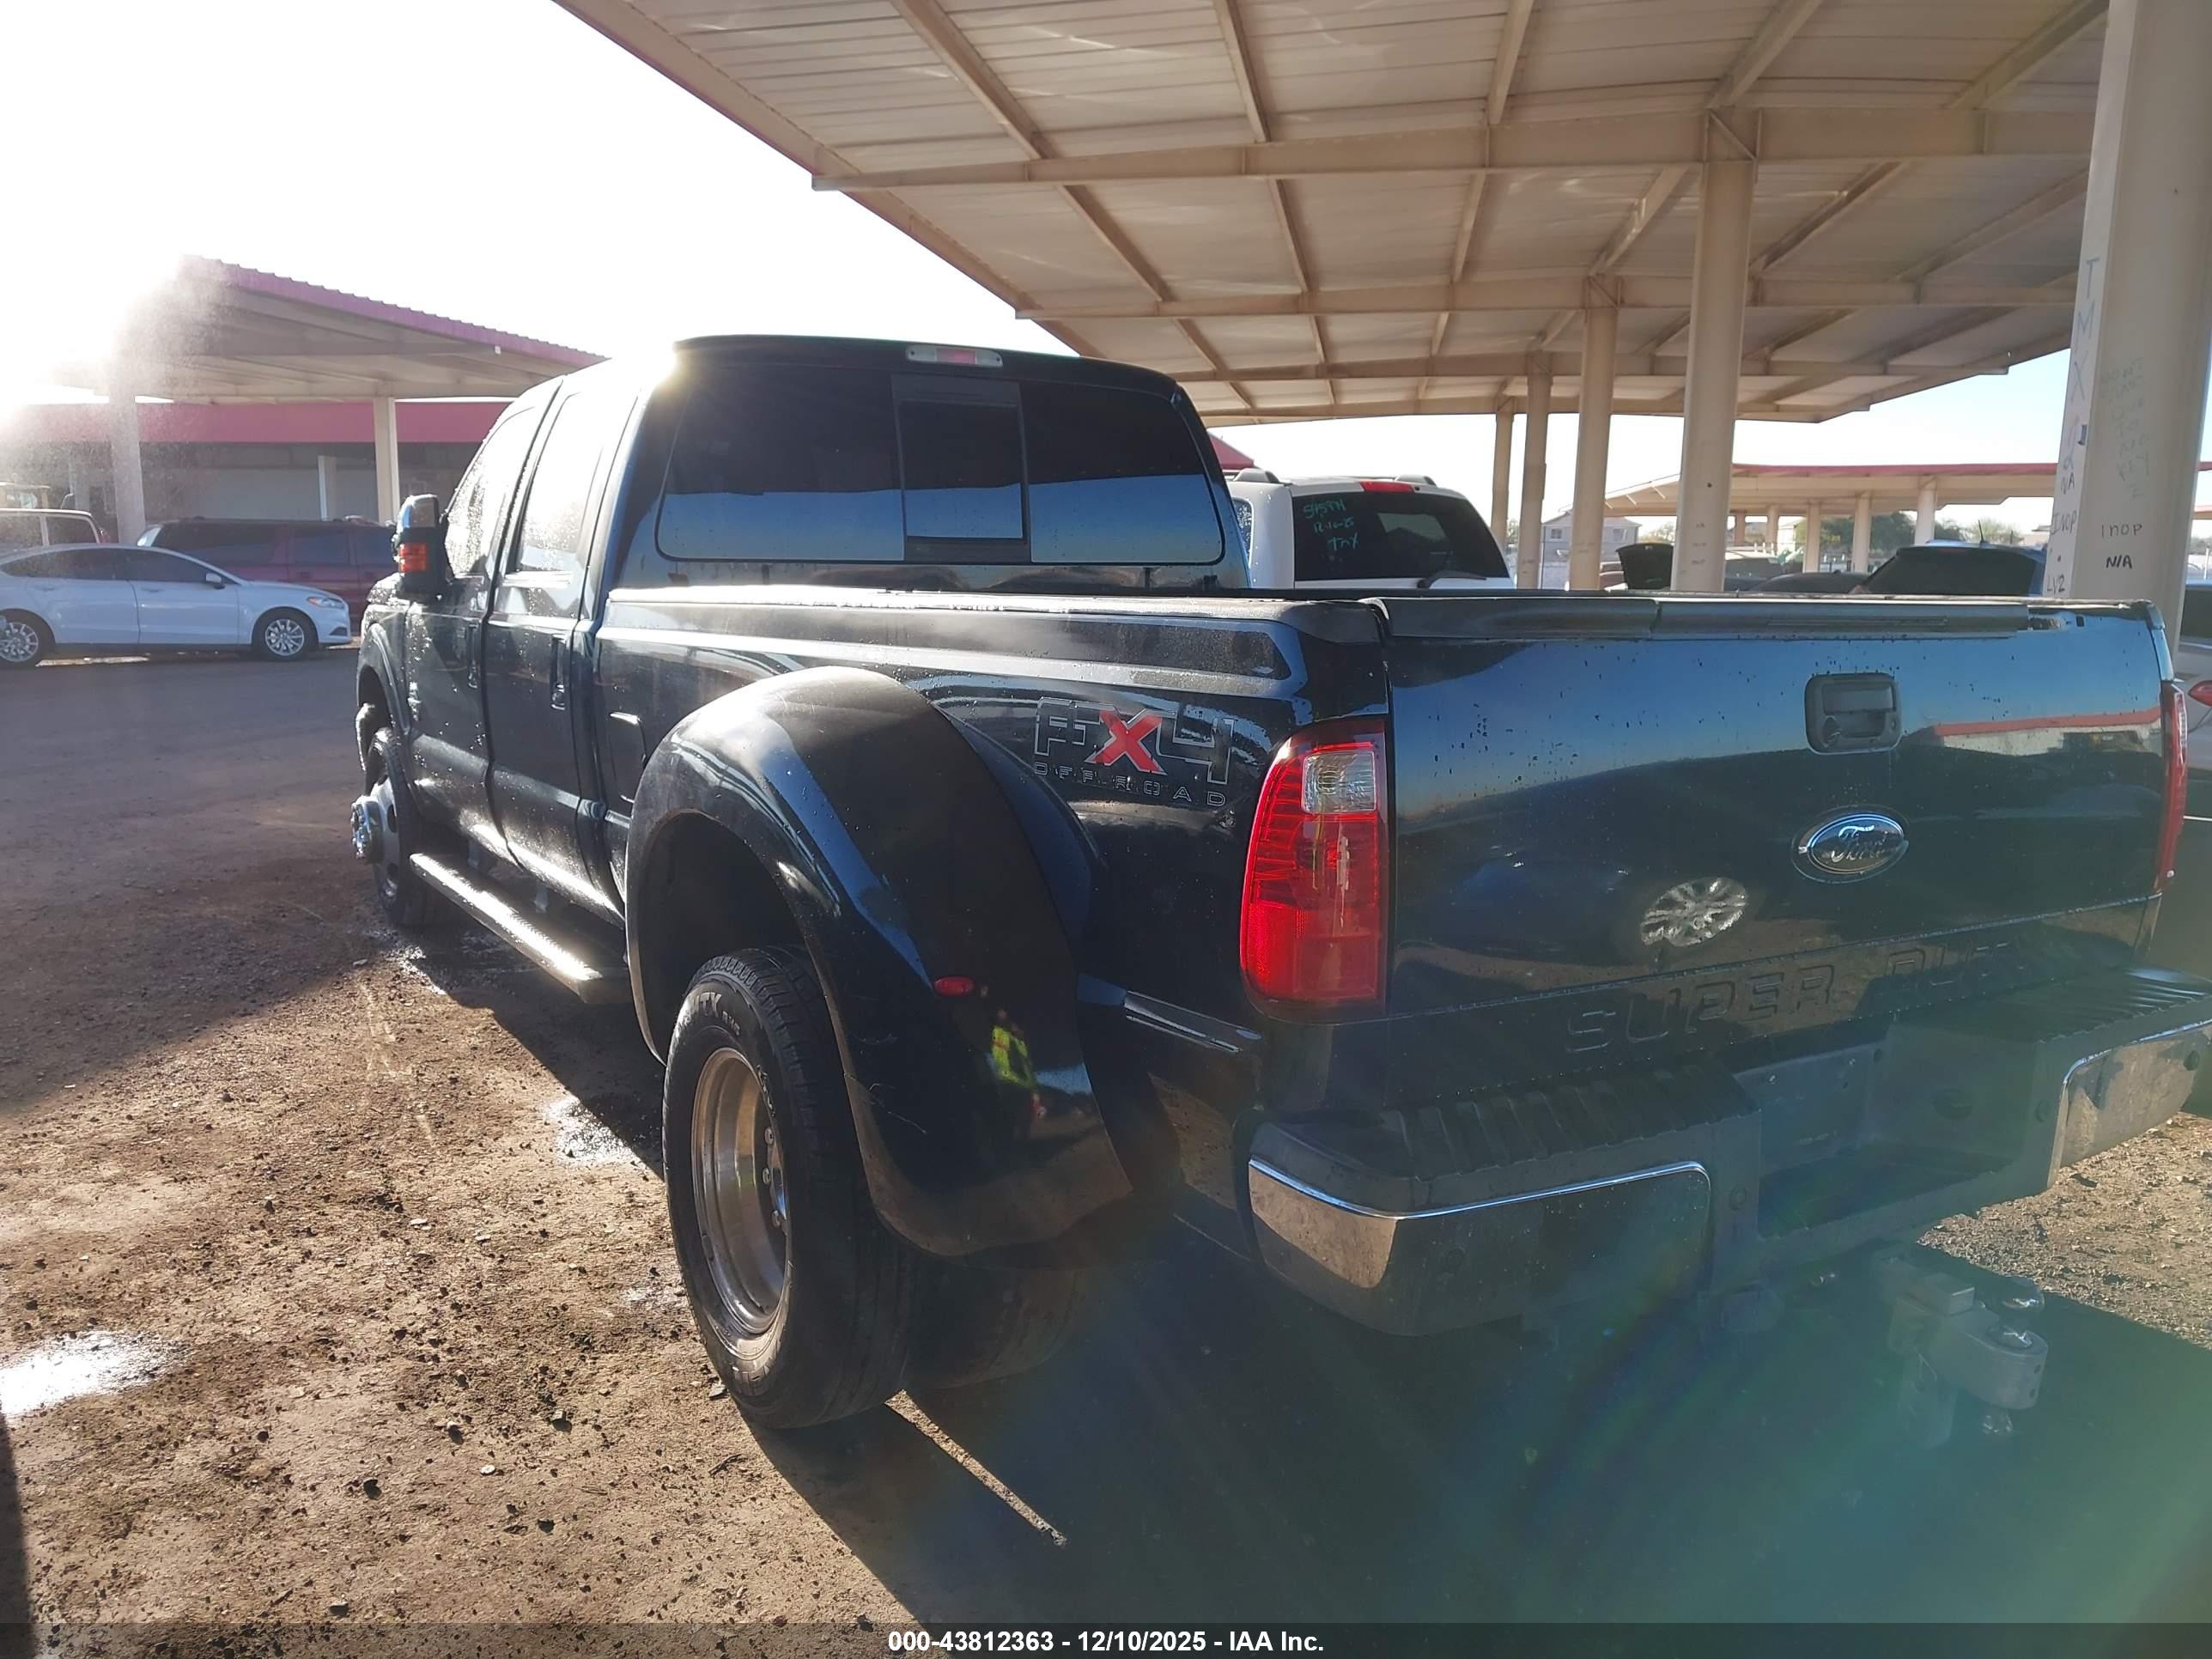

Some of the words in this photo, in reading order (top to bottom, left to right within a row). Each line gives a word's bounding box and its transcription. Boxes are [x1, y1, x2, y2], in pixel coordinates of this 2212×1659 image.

[2106, 555, 2133, 569] N/A
[1034, 696, 1234, 785] FX4
[1115, 775, 1227, 807] ROAD
[1565, 963, 1835, 1053] SUPER
